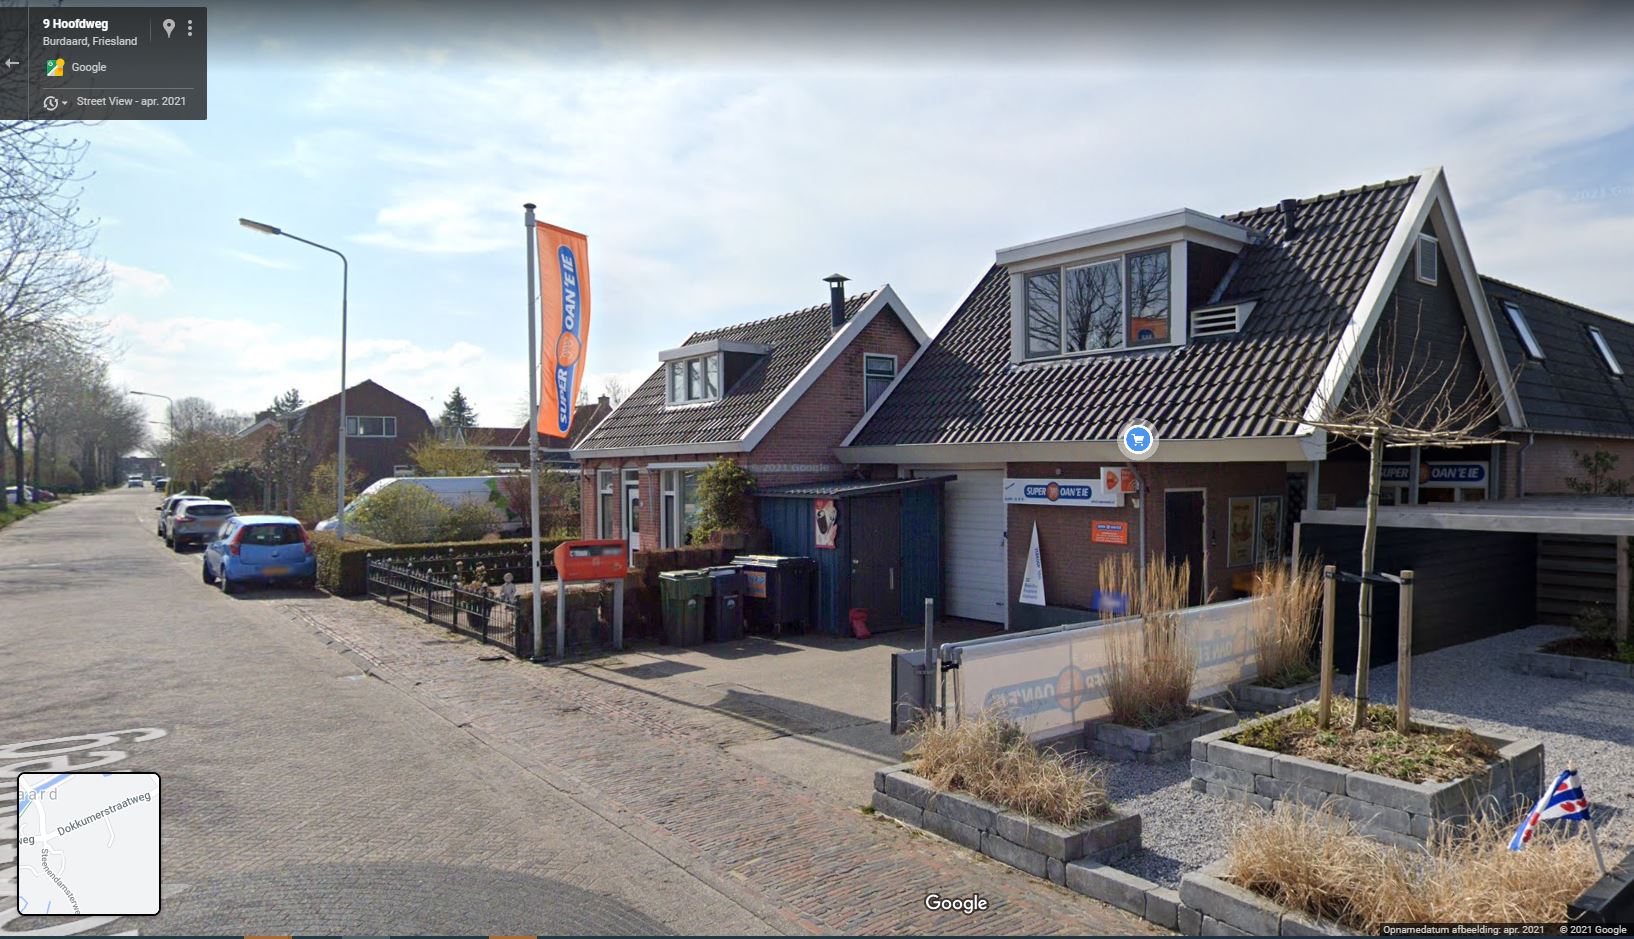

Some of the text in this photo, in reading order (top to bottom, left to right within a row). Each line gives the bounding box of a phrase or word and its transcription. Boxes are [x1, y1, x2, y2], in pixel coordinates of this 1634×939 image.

[558, 368, 568, 424] SUPER
[1381, 467, 1409, 478] UPER
[1026, 487, 1047, 496] SUPER
